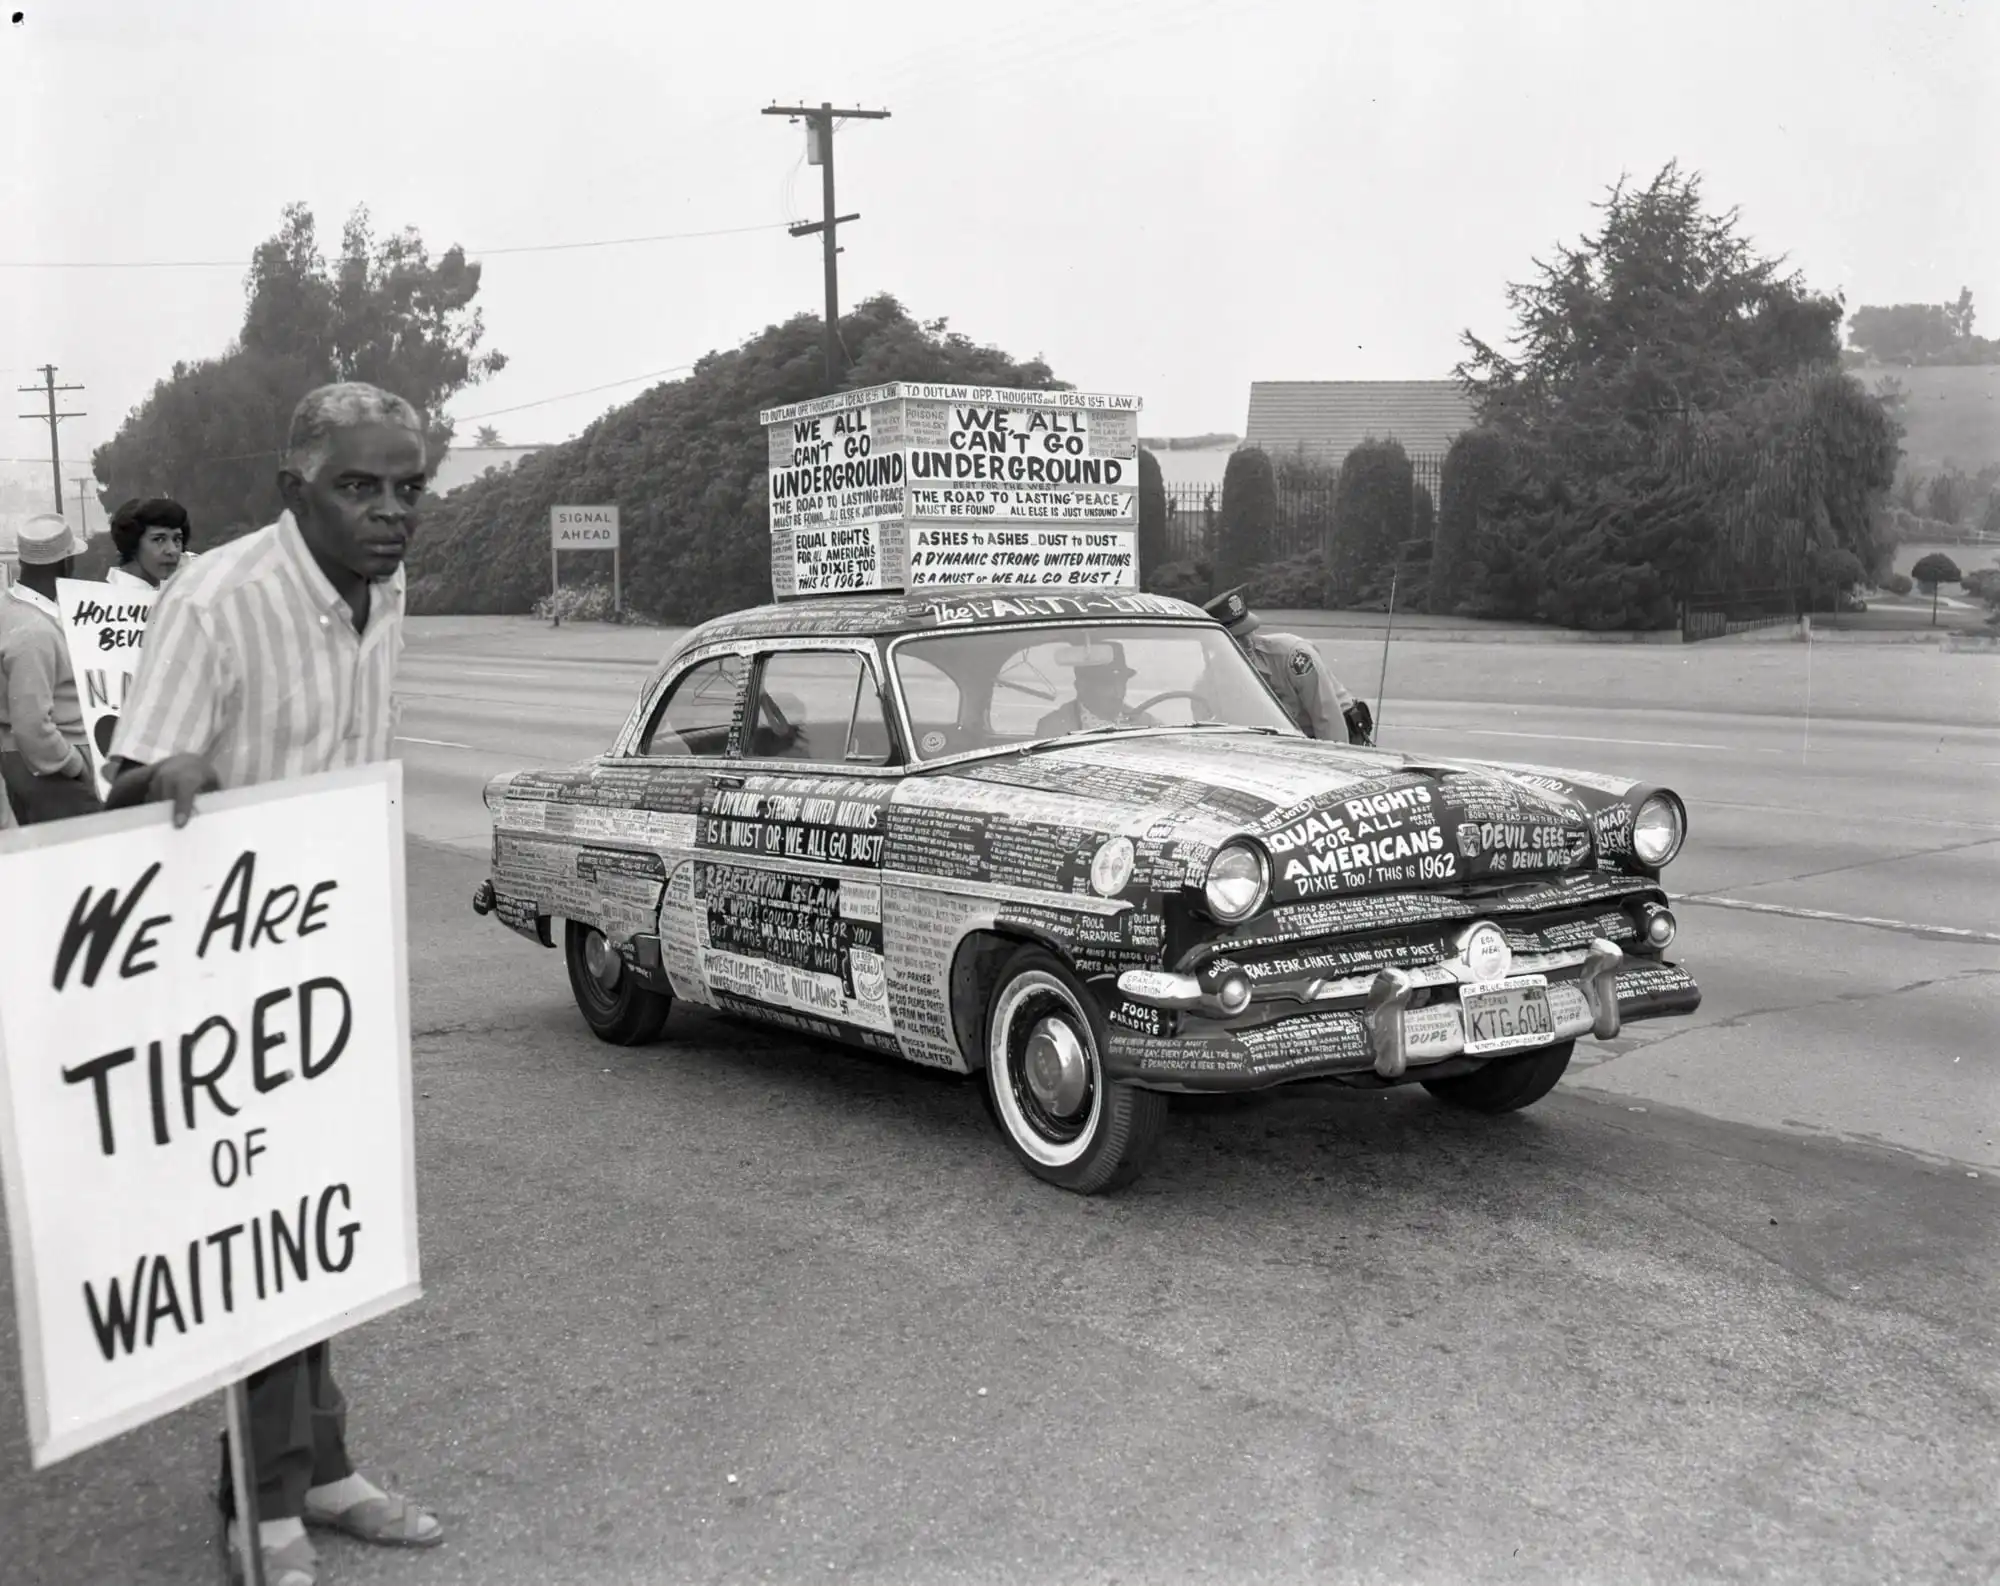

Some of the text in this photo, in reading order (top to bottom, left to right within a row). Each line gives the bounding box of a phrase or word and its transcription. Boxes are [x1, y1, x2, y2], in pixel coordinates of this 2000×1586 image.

[904, 385, 920, 396] TO
[923, 386, 967, 399] OUTLAW
[996, 391, 1043, 404] THOUGHTS
[1060, 394, 1085, 406] IDEAS
[794, 420, 821, 443] WE
[834, 410, 867, 434] ALL
[956, 408, 1009, 432] WE
[1029, 411, 1086, 432] ALL
[794, 440, 833, 467] CAN'T
[844, 435, 870, 458] GO
[950, 429, 1030, 454] CAN'T
[1043, 433, 1083, 455] GO
[773, 452, 903, 500] UNDERGROUND
[912, 451, 1121, 484] UNDERGROUND
[981, 482, 998, 490] FOR
[1028, 483, 1060, 491] WEST
[773, 500, 791, 515] THE
[796, 497, 823, 512] ROAD
[828, 495, 837, 508] TO
[841, 490, 879, 507] LASTING
[912, 491, 938, 503] THE
[944, 491, 985, 503] ROAD
[993, 492, 1009, 503] TO
[1016, 491, 1072, 505] LASTING
[559, 513, 613, 524] SIGNAL
[773, 517, 792, 529] MUST
[794, 515, 802, 526] BE
[840, 507, 854, 520] ELSE
[915, 503, 947, 516] MUST
[950, 504, 962, 515] BE
[1010, 506, 1024, 516] ALL
[1028, 507, 1048, 517] ELSE
[1051, 507, 1058, 516] IS
[1062, 507, 1082, 518] JUST
[1084, 508, 1118, 518] UNSOUND
[560, 529, 611, 541] AHEAD
[796, 527, 870, 550] EQUAL RIGHTS
[918, 531, 968, 546] ASHES
[972, 533, 984, 546] to
[1072, 535, 1082, 546] to
[797, 550, 811, 564] FOR
[826, 545, 876, 562] AMERICANS
[912, 552, 1131, 567] A DYNAMIC STRONG UNITED NATIONS
[821, 559, 875, 577] DIXIE TOO
[912, 572, 925, 584] IS
[928, 573, 937, 583] A
[939, 572, 974, 584] MUST
[976, 575, 987, 583] or
[991, 573, 1014, 583] WE
[1015, 572, 1036, 583] ALL
[1042, 572, 1062, 583] GO
[798, 576, 818, 590] THIS
[820, 575, 831, 588] IS
[925, 603, 973, 626] The
[711, 790, 722, 814] A
[719, 791, 765, 819] DYNAMIC
[764, 795, 801, 821] STRONG
[801, 799, 836, 825] UNITED
[835, 801, 881, 829] NATIONS
[1344, 786, 1432, 821] RIGHTS
[1599, 810, 1625, 830] MAD
[707, 819, 718, 843] IS
[720, 821, 727, 845] A
[730, 822, 762, 849] MUST
[807, 829, 827, 857] ALL
[1311, 814, 1402, 854] FOR ALL
[1481, 822, 1529, 850] DEVIL
[1532, 826, 1566, 849] SEES
[1601, 828, 1626, 849] JEW
[1284, 826, 1444, 880] AMERICANS
[1489, 848, 1572, 871] AS DEVIL DOES
[1294, 852, 1457, 897] DIXIE THIS IS 1962
[706, 865, 786, 900] REGISTRATION
[807, 885, 839, 910] LAW
[706, 893, 725, 914] FOR
[763, 909, 793, 926] COULD
[798, 912, 810, 930] BE
[814, 917, 829, 933] ME
[833, 921, 848, 938] OR
[852, 925, 872, 945] YOU
[1081, 915, 1105, 929] FOOLS
[1133, 913, 1161, 925] OUTLAW
[1080, 931, 1122, 943] PARADISE
[1134, 925, 1157, 936] PROFIT
[1256, 932, 1300, 945] ETHIOPIA
[710, 920, 810, 964] BUT CALLING
[1076, 959, 1102, 972] FACTS
[1349, 949, 1373, 963] LONG
[1374, 949, 1394, 959] OUT
[1396, 946, 1408, 957] OF
[763, 967, 788, 996] DIXIE
[791, 975, 837, 1009] OUTLAWS
[1479, 983, 1500, 993] BLUE
[1109, 1010, 1160, 1035] PARADISE
[1121, 1001, 1159, 1022] FOOLS
[1556, 1012, 1581, 1026] DUPE
[61, 976, 353, 1157] TIRED
[1148, 1060, 1189, 1070] DEMOCRACY
[211, 1127, 268, 1189] OF
[84, 1183, 362, 1362] WAITING
